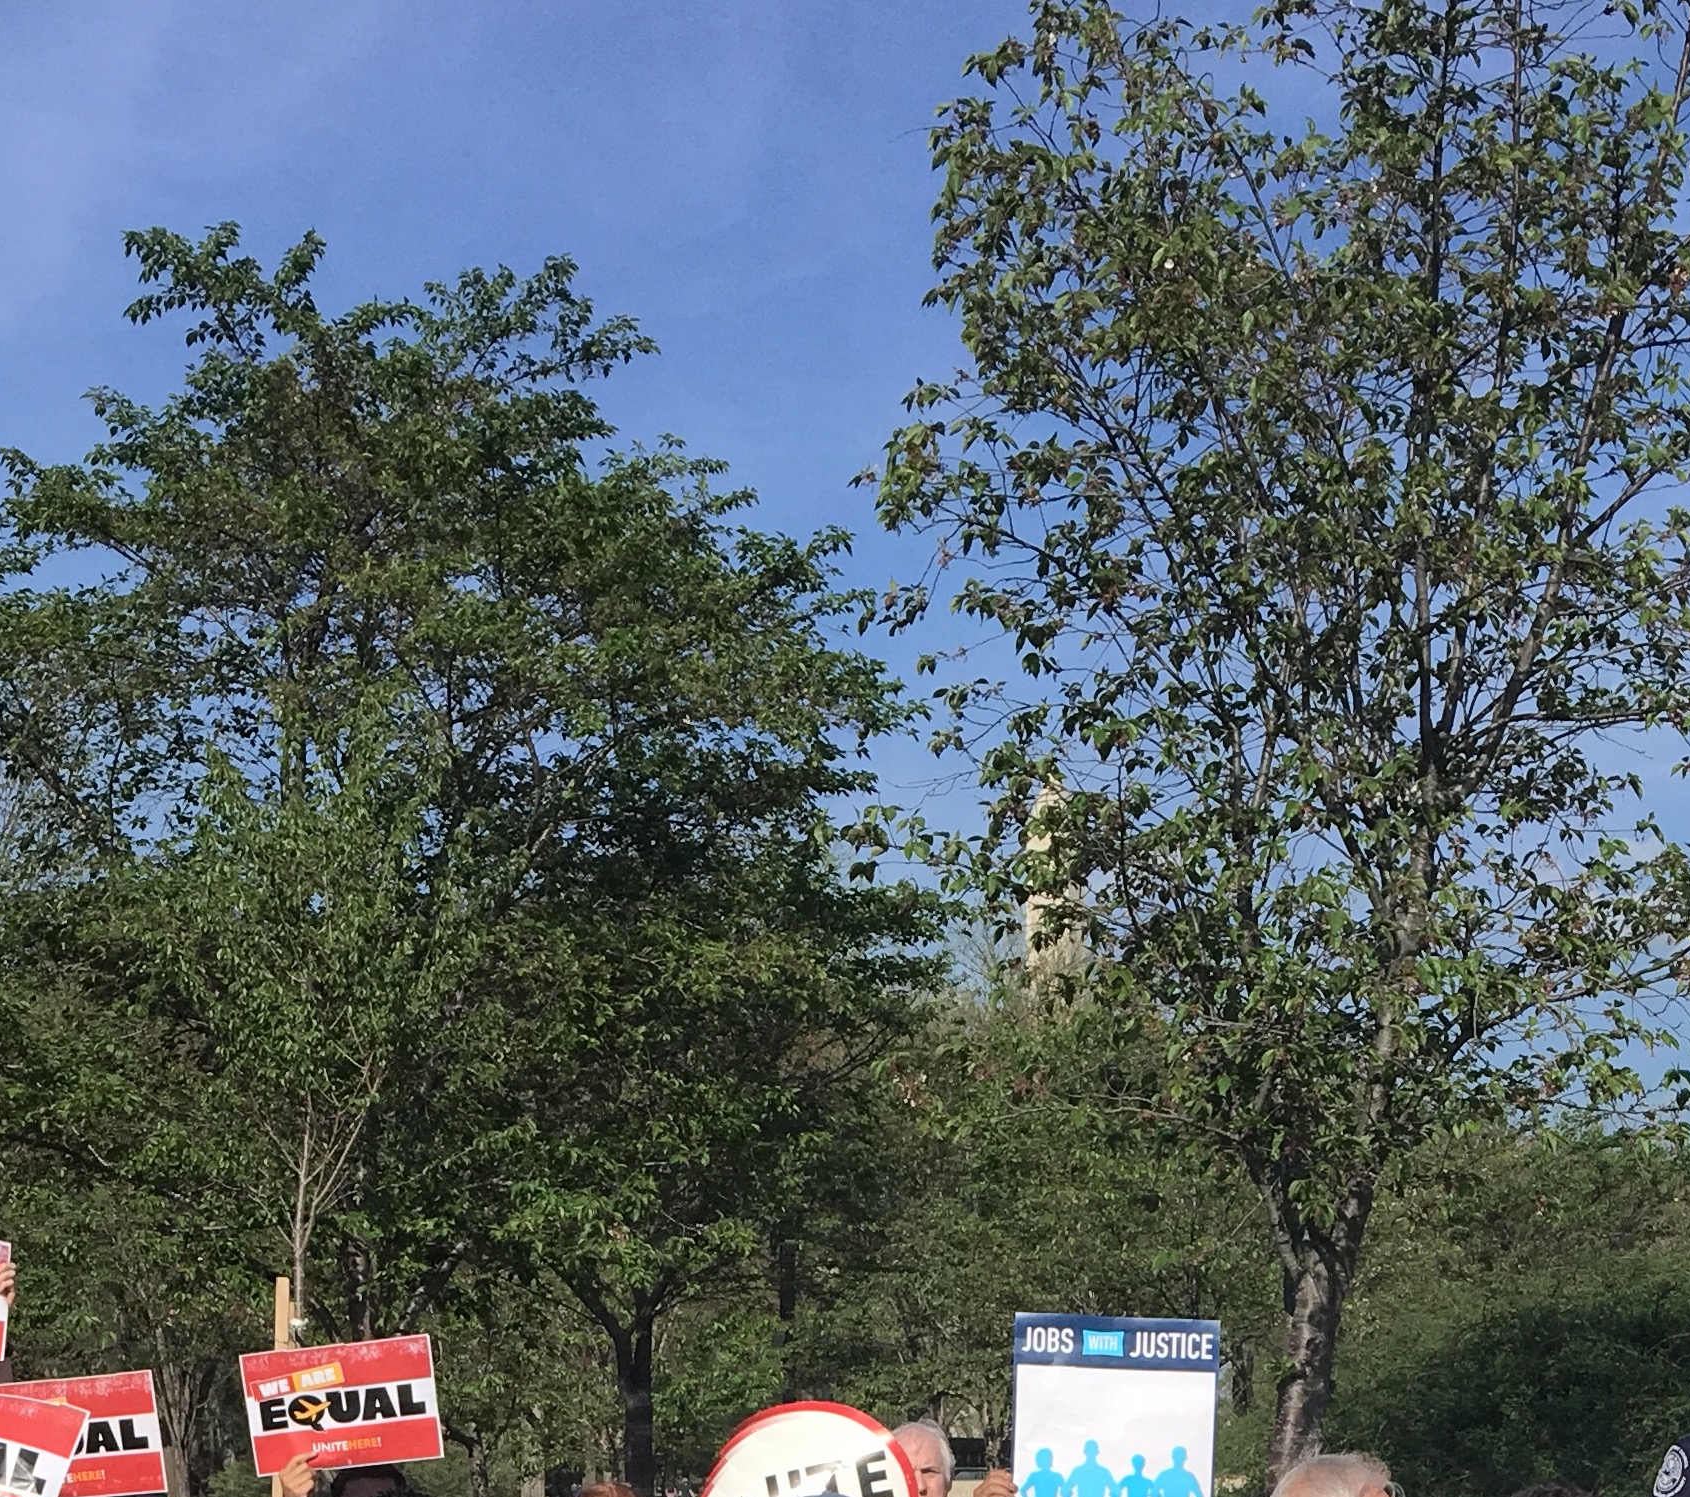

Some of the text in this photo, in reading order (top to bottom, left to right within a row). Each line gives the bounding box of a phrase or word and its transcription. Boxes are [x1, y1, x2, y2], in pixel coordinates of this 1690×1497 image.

[1022, 1326, 1214, 1360] JOBS WITH JUSTICE
[258, 1367, 337, 1397] WE ARE
[259, 1383, 426, 1432] EQUAL
[312, 1436, 382, 1453] UNITEHERE!
